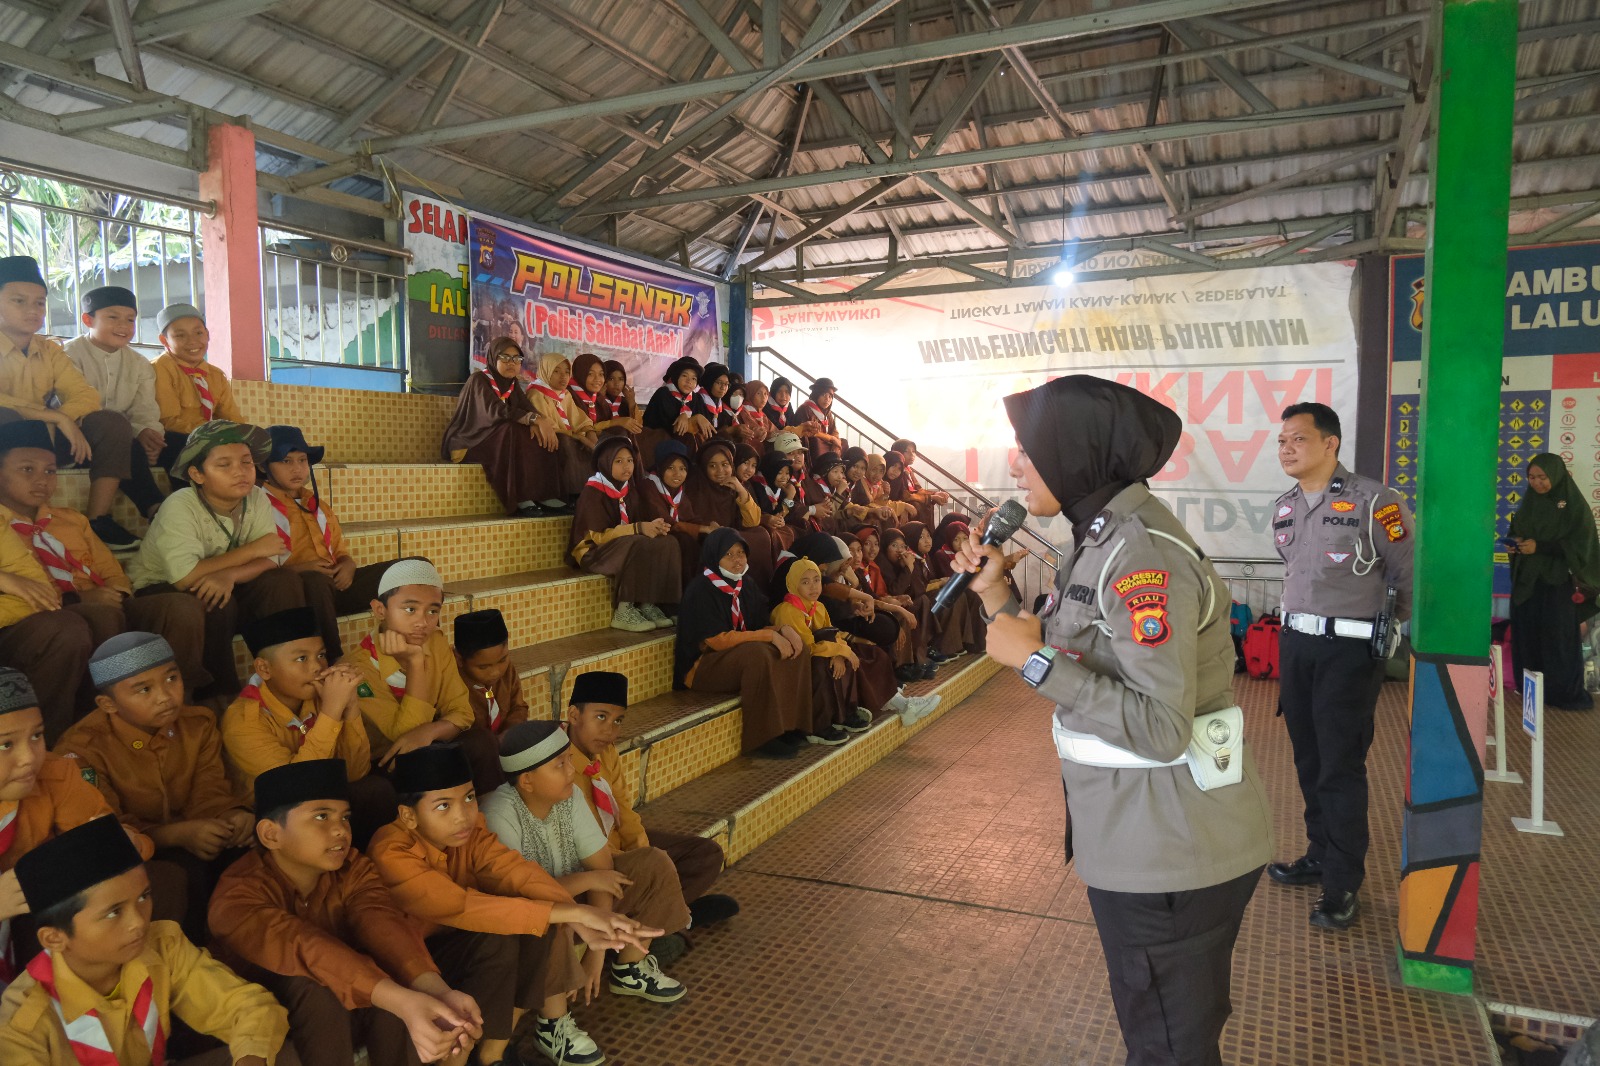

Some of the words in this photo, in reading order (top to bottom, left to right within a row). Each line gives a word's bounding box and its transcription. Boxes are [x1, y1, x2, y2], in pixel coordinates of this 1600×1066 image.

[511, 252, 694, 328] POLSANAK
[1511, 300, 1600, 330] LALU
[585, 313, 644, 350] Sahabat
[1323, 516, 1360, 528] POLRI
[1116, 572, 1163, 590] POLRESTA
[1119, 578, 1163, 594] PEKANBARU
[1132, 595, 1159, 605] RIAU
